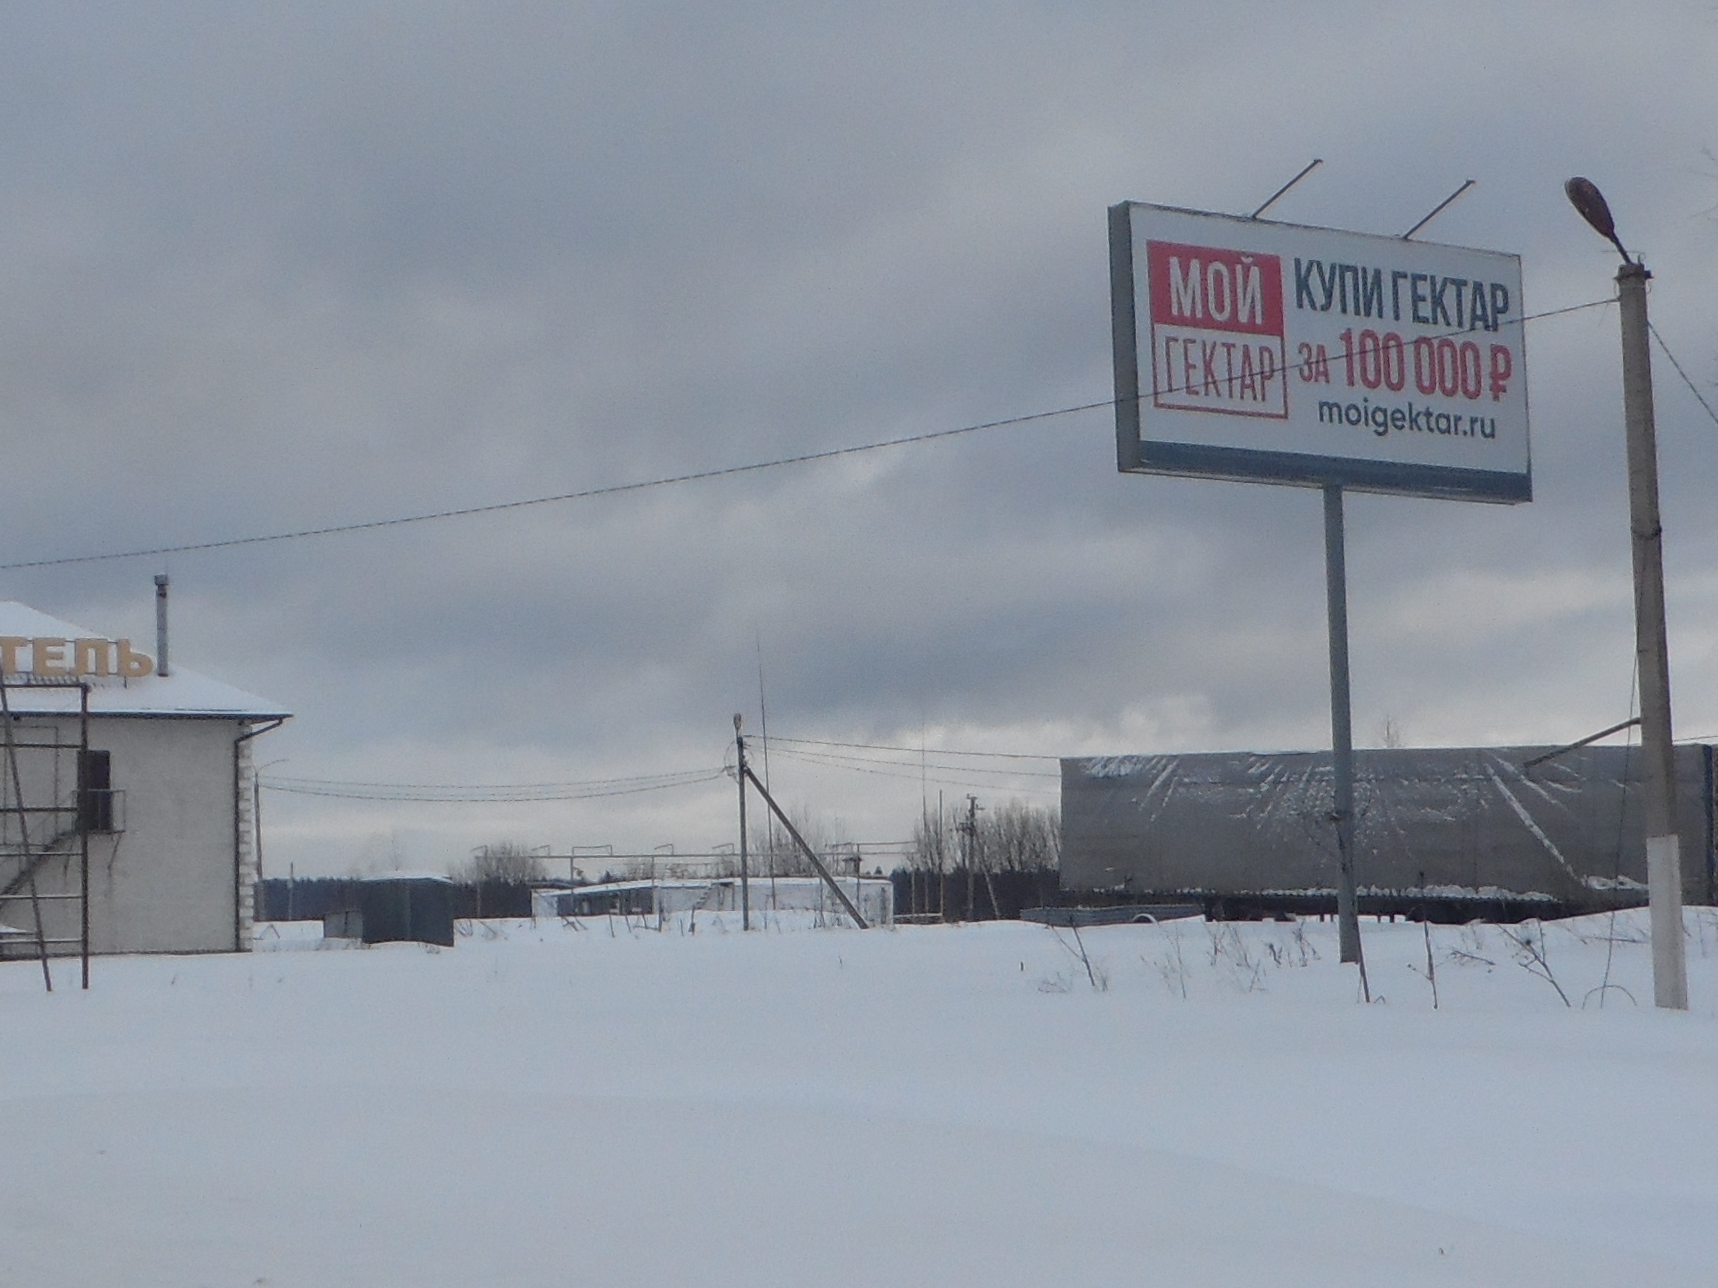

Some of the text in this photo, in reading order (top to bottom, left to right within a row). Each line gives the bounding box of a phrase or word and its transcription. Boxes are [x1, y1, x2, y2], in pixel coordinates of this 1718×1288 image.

[1168, 255, 1263, 325] МОЙ
[1293, 257, 1510, 332] КУПИ ГЕКТАР
[1164, 336, 1275, 403] ГЕКТАР
[1297, 341, 1331, 384] ЗА
[1318, 396, 1497, 440] moigektar.ru
